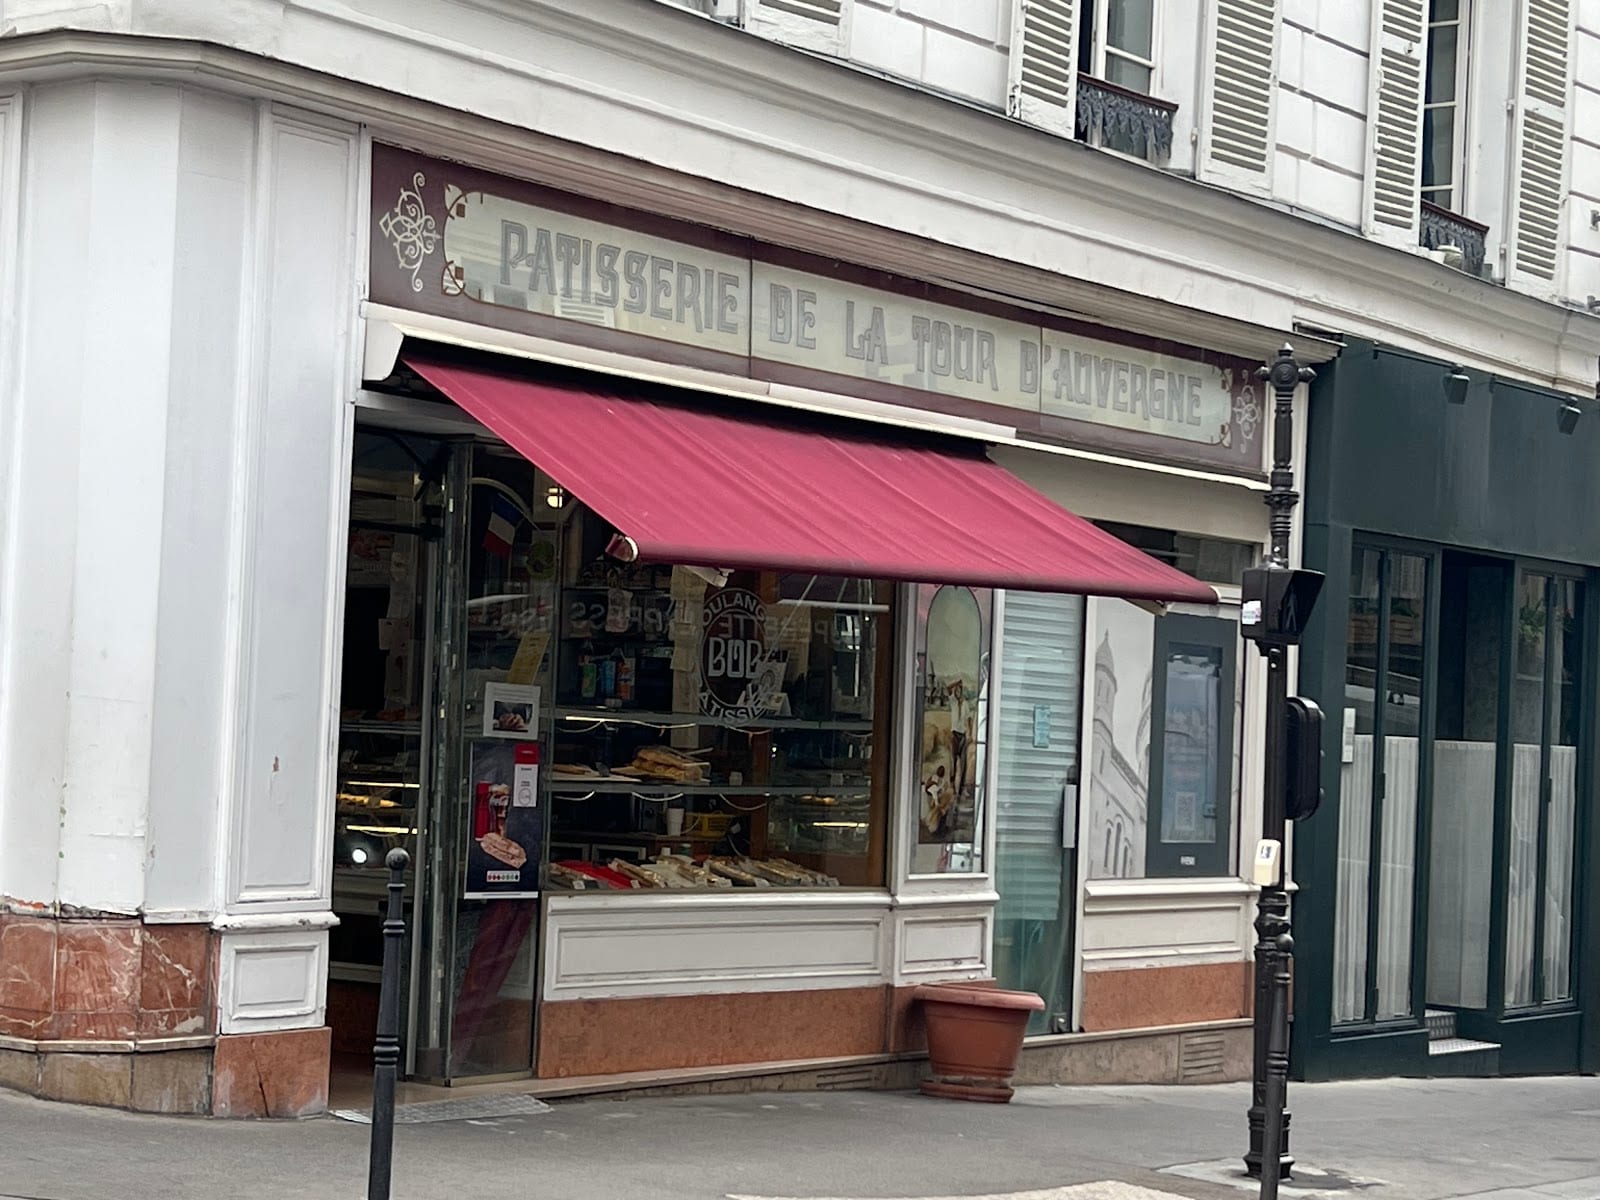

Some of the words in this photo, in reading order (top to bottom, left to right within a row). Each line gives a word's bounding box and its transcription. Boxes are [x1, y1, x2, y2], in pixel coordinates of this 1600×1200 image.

[500, 219, 740, 334] PATISSERIE
[769, 282, 817, 350] DE
[845, 300, 889, 365] LA
[912, 315, 999, 391] TOUR
[1019, 339, 1202, 426] D'AUVERGNE
